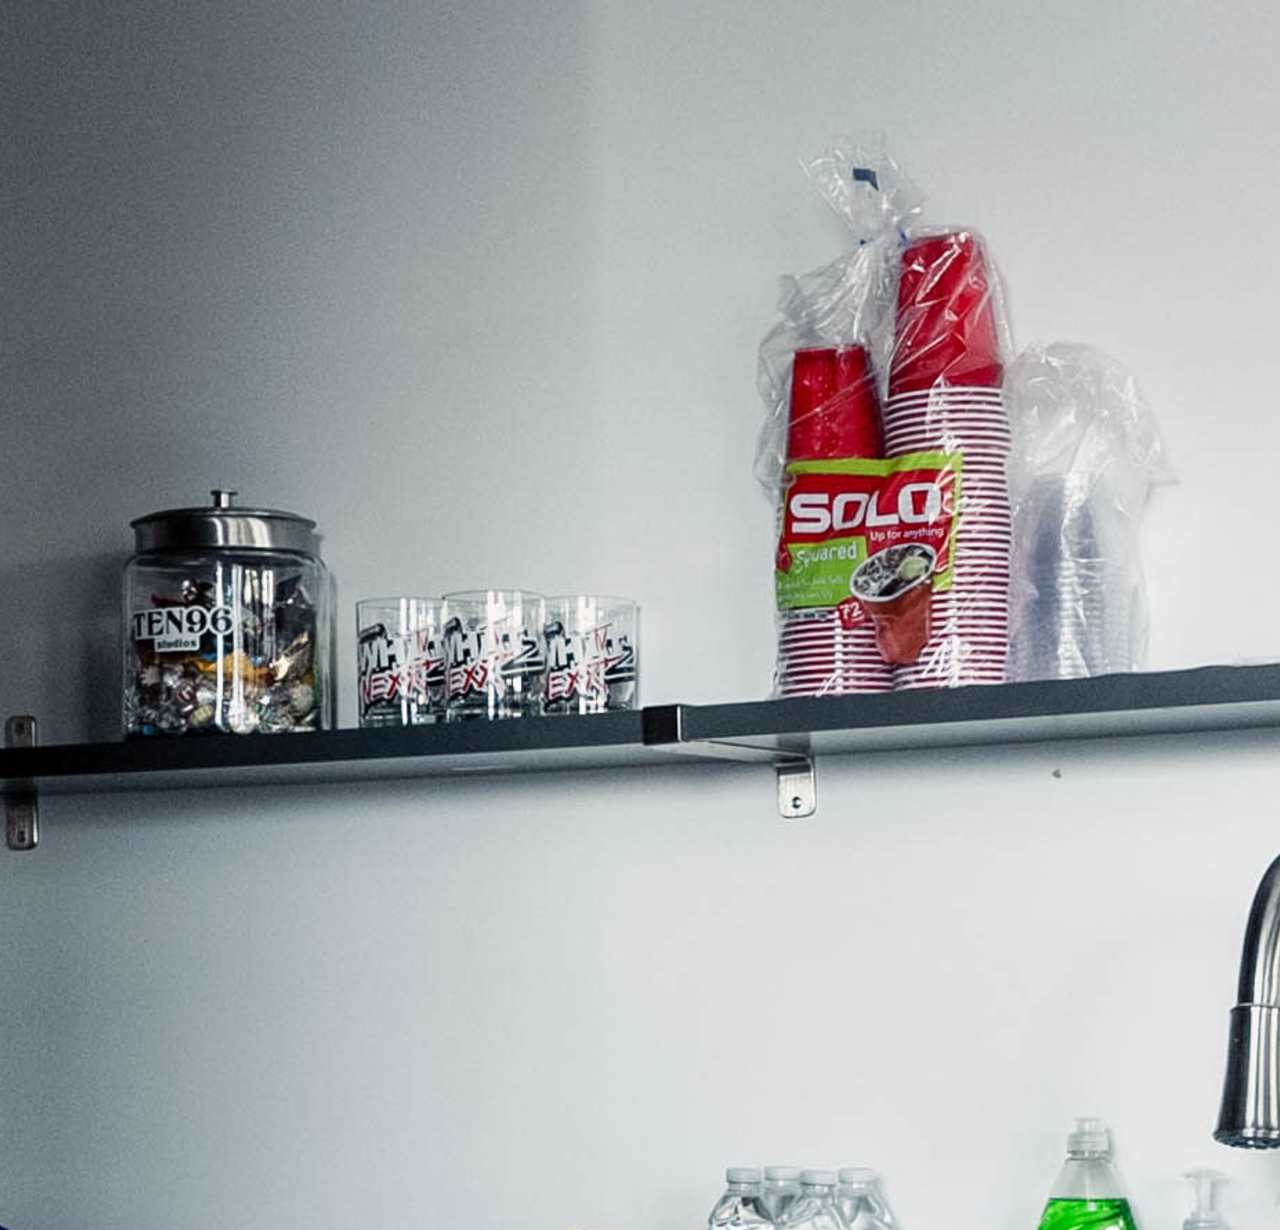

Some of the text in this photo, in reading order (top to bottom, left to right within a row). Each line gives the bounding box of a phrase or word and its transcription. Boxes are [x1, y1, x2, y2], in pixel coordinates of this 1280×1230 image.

[790, 483, 942, 534] SOLO
[870, 528, 945, 542] Up for anything
[794, 541, 857, 573] Squared
[133, 607, 233, 638] TEN96
